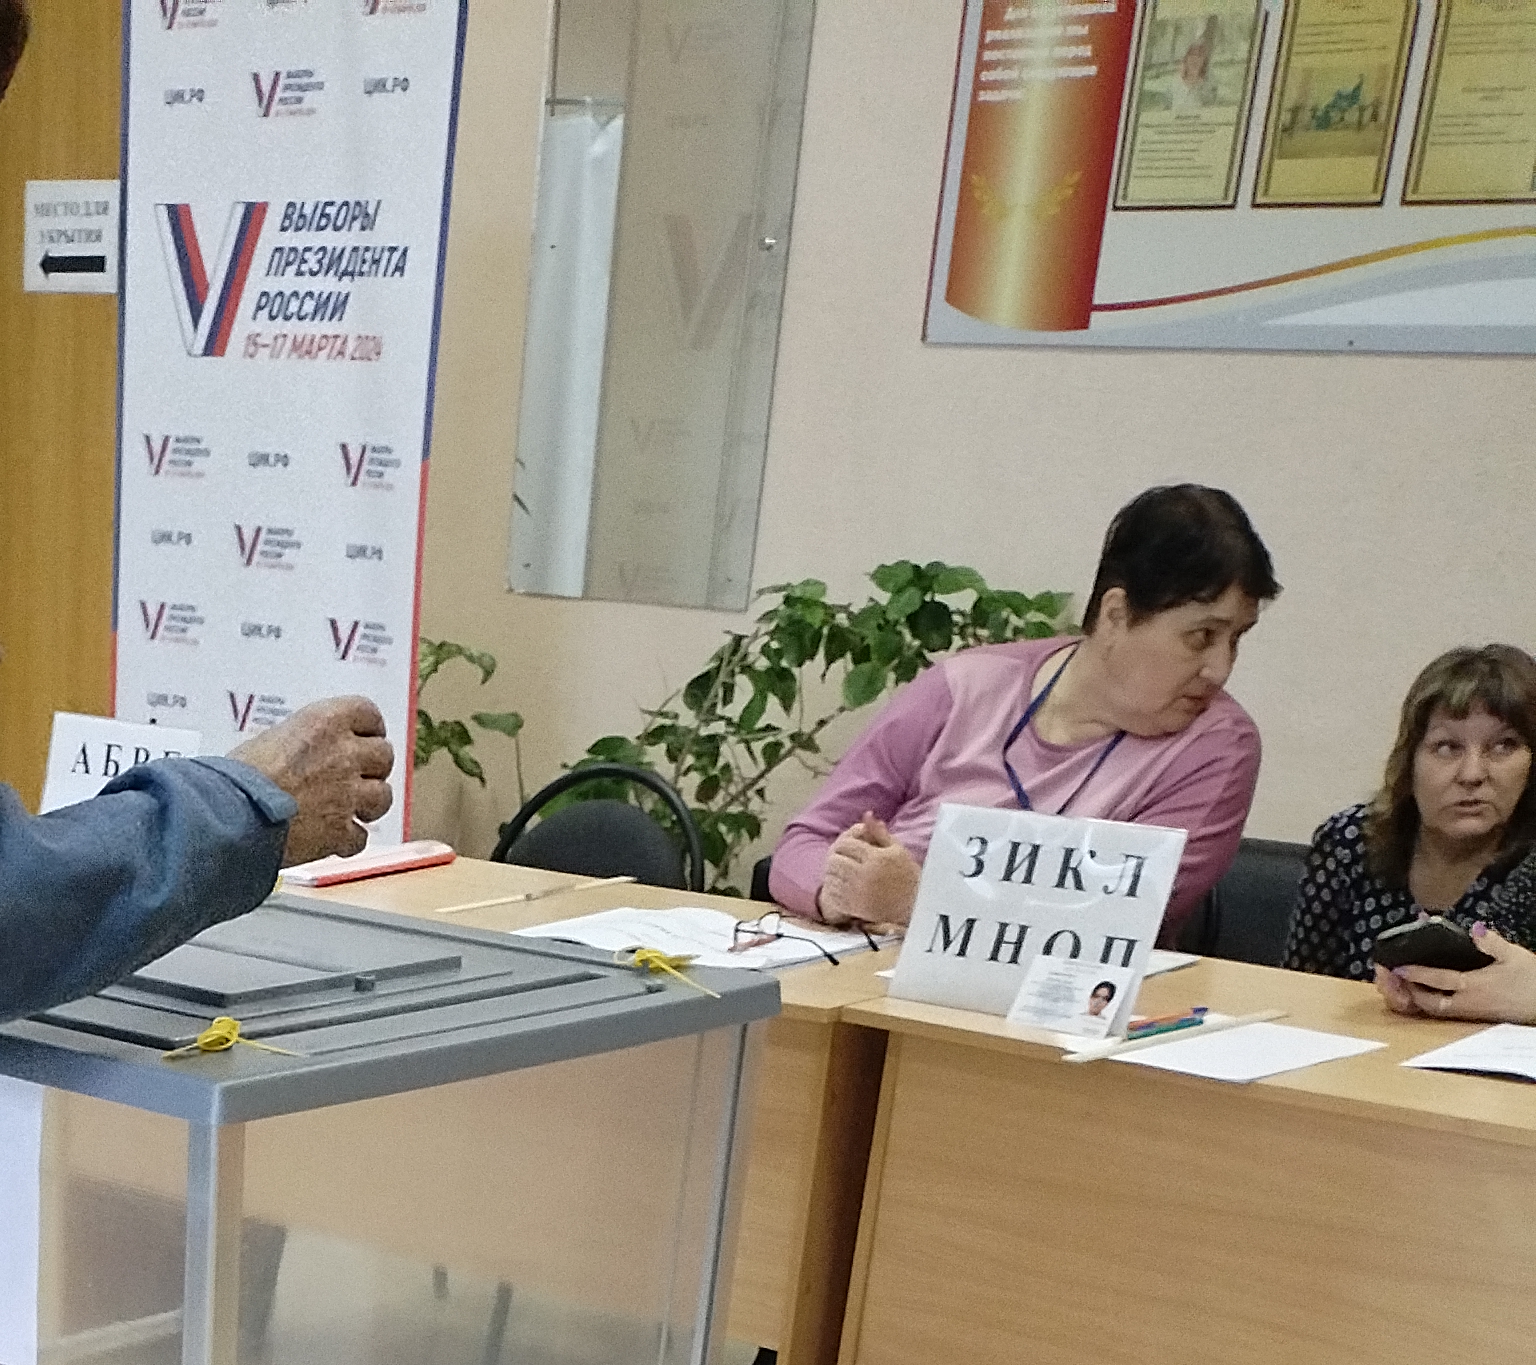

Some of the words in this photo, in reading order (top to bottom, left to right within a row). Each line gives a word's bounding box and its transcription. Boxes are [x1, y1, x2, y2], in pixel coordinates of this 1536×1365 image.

[279, 199, 382, 233] ВЫБОРЫ
[265, 245, 408, 279] ПРЕЗИДЕНТА
[251, 291, 350, 322] РОССИИ
[288, 333, 348, 361] МАРТА
